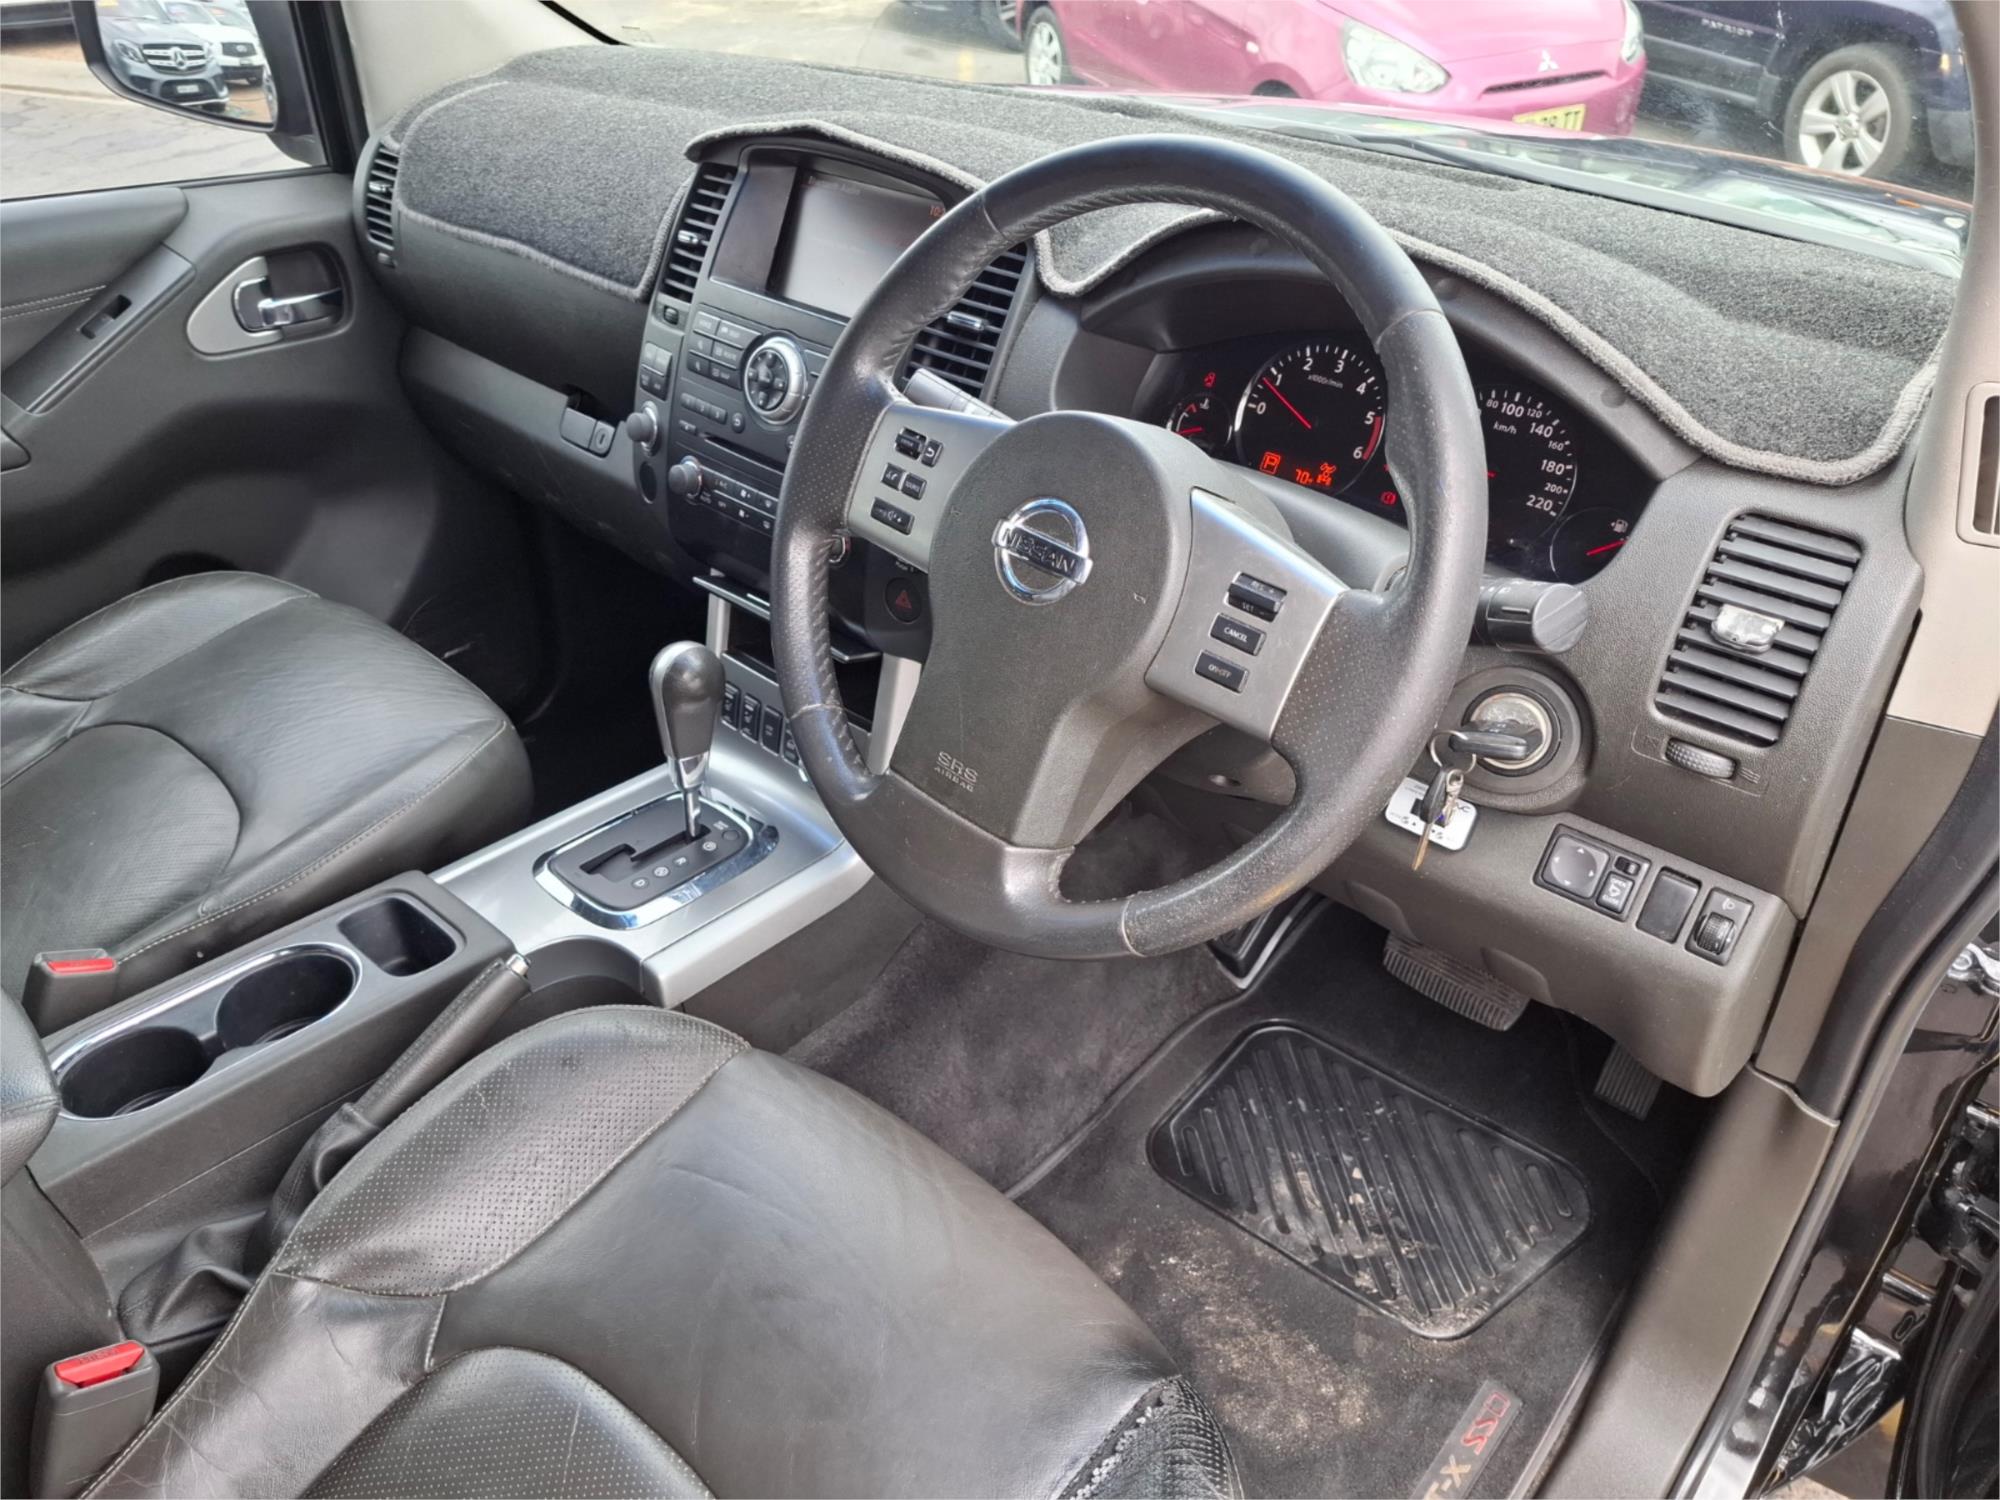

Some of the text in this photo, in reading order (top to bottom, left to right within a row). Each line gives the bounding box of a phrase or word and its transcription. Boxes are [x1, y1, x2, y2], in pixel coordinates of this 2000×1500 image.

[1701, 18, 1754, 37] PATRIOT
[1303, 358, 1314, 371] 2
[1334, 360, 1344, 373] 3
[1274, 373, 1282, 386] 1
[1356, 382, 1367, 395] 4
[1256, 402, 1267, 414] 0
[1486, 399, 1499, 409] 80
[1501, 402, 1524, 417] 100
[1364, 411, 1375, 425] 5
[1527, 408, 1543, 418] 120
[1493, 421, 1517, 435] km/h
[1529, 422, 1553, 438] 140
[1548, 440, 1565, 451] 160
[1353, 446, 1363, 460] 6
[1540, 459, 1565, 475] 180
[1544, 482, 1563, 494] 200
[1526, 494, 1553, 511] 220
[1001, 528, 1075, 572] NISSAN
[1223, 627, 1248, 643] CANCEL
[938, 751, 978, 783] SRS
